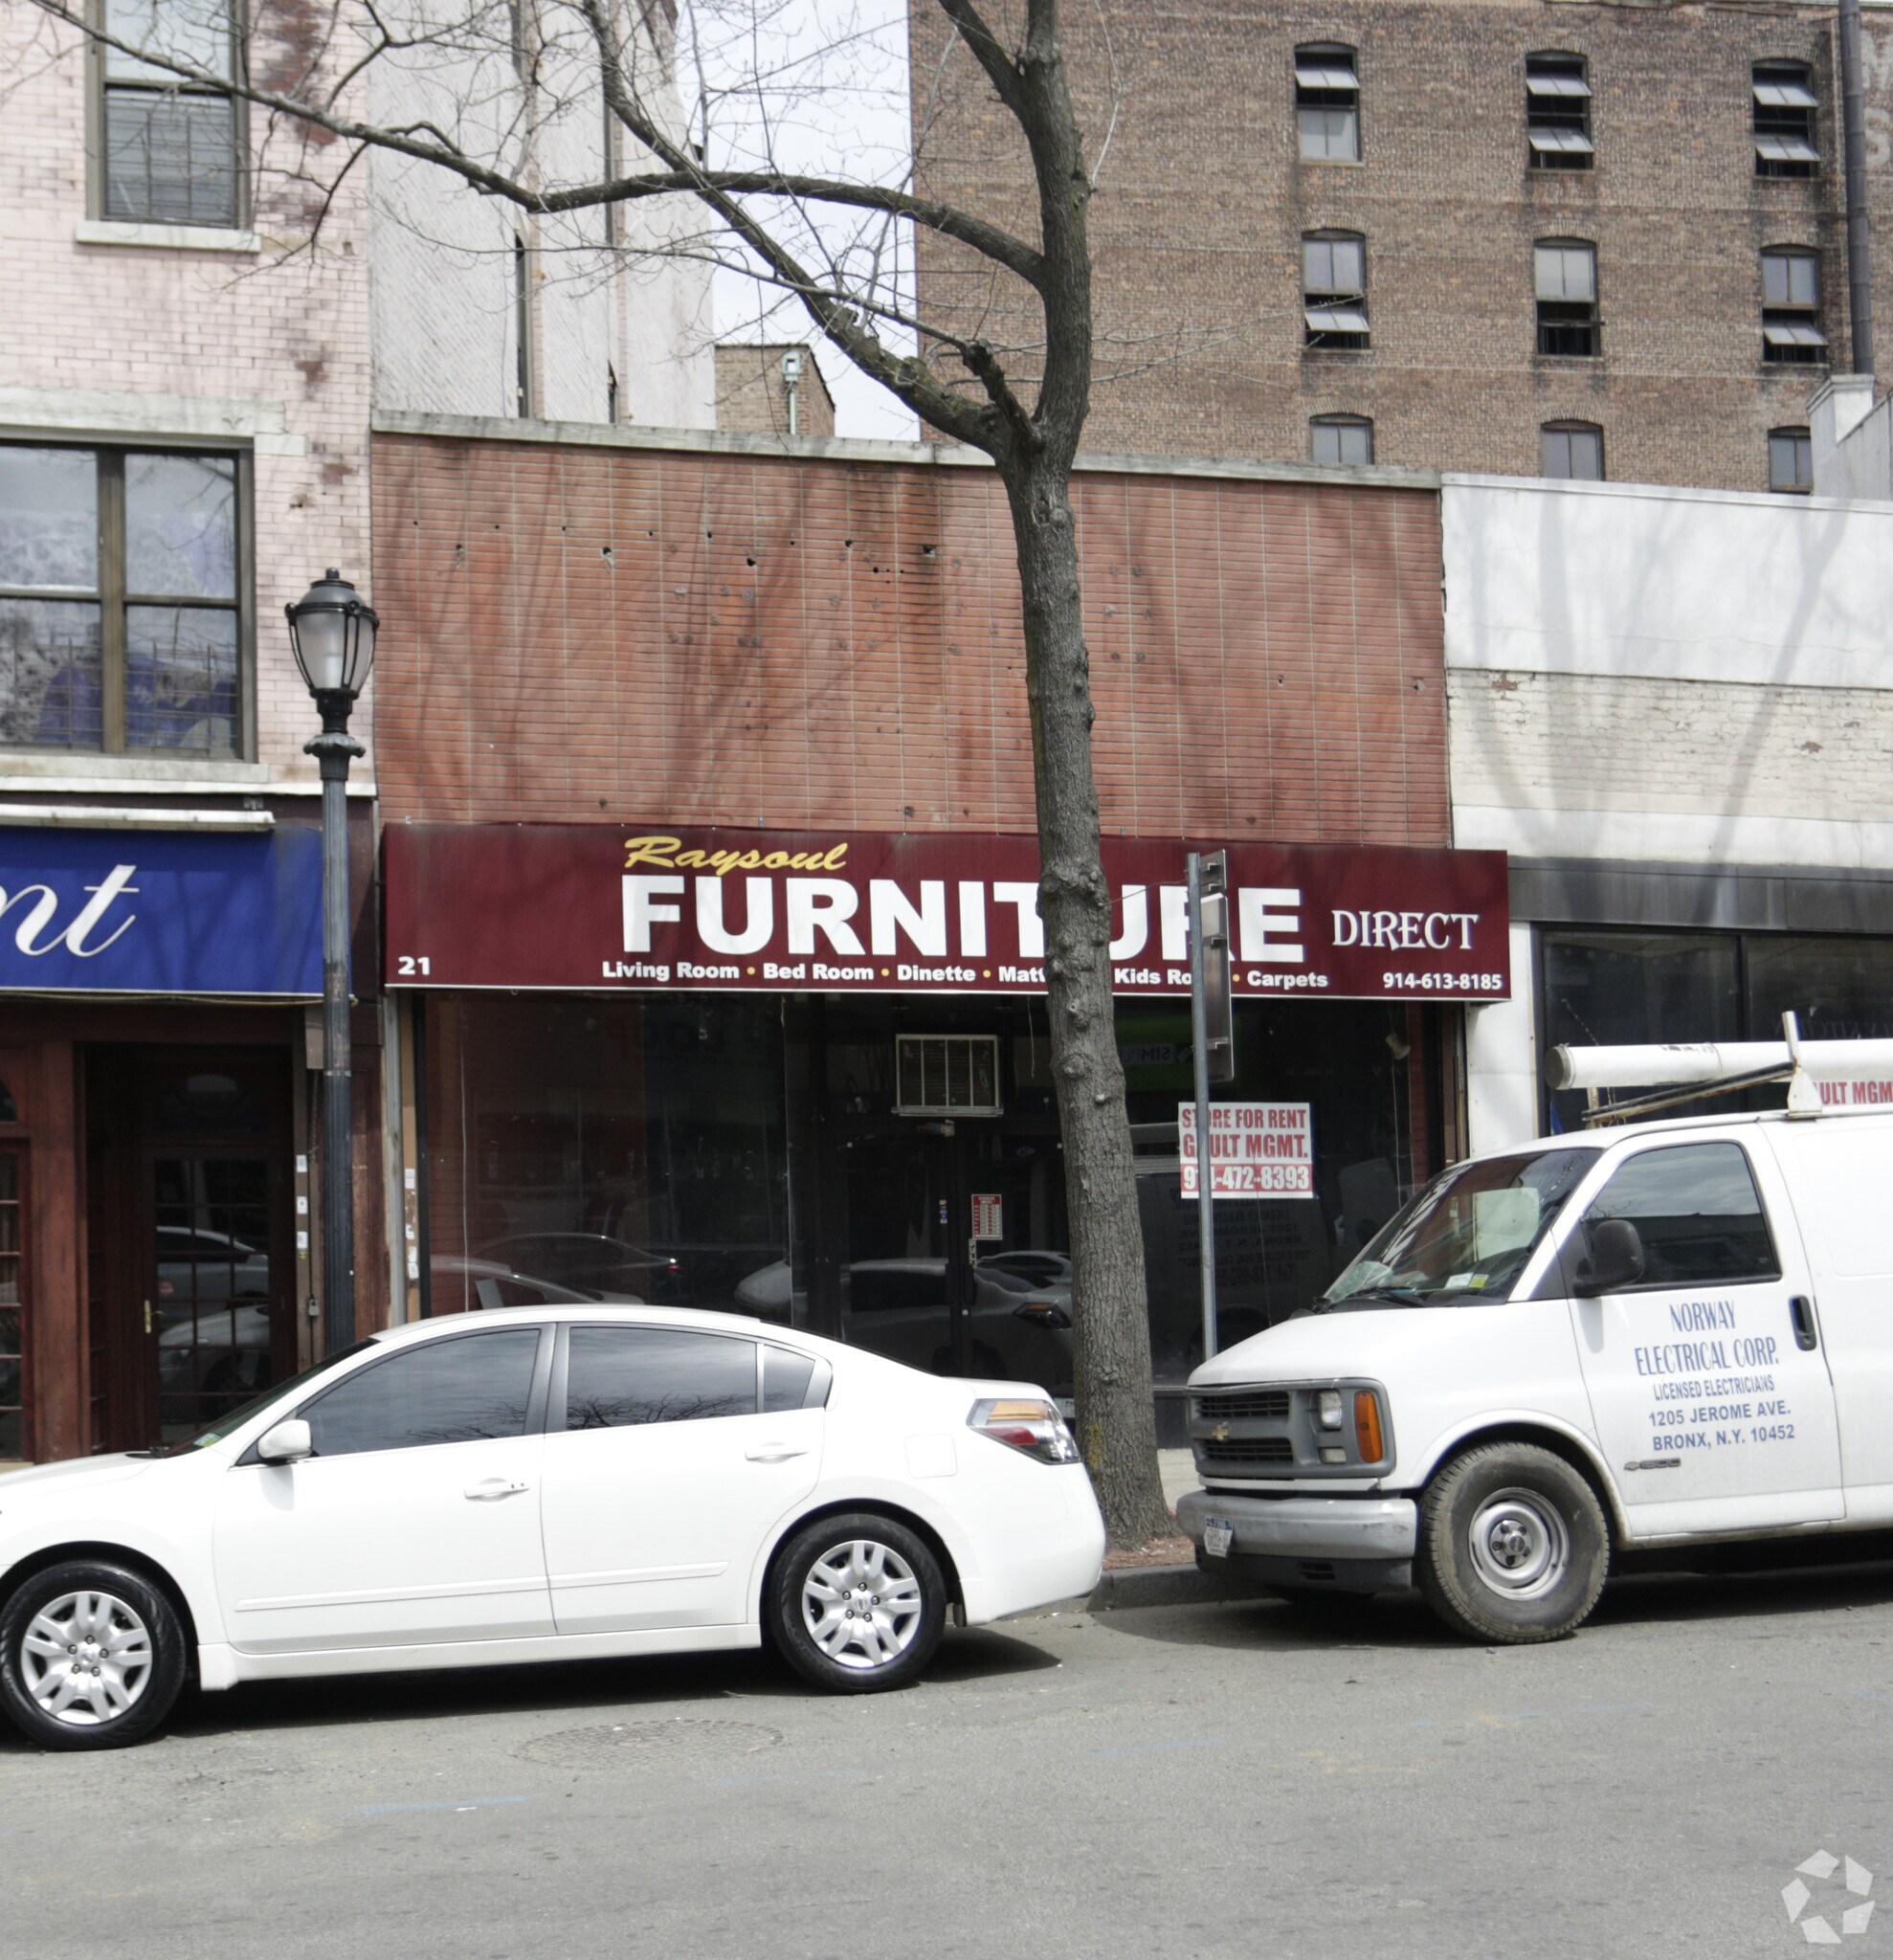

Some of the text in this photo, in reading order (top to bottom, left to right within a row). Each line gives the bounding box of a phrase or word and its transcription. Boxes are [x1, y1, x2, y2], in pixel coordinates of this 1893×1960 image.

[624, 835, 848, 876] Raysoul
[1331, 910, 1479, 951] DIRECT
[398, 956, 430, 976] 21
[602, 961, 670, 982] Living
[678, 962, 740, 979] Room
[764, 963, 806, 980] Bed
[813, 964, 874, 981] Room
[898, 965, 976, 982] Dinette
[1114, 968, 1161, 985] Kids
[1167, 969, 1193, 985] Ro
[1247, 970, 1328, 990] Carpets
[1383, 972, 1503, 991] 914-613-8185
[1815, 1081, 1847, 1104] ULT
[1182, 1108, 1306, 1128] SRE FOR RENT
[1183, 1133, 1308, 1158] GULT MGMT.
[1184, 1166, 1309, 1190] 9-472-8393
[1669, 1300, 1736, 1332] NORWAY
[1635, 1336, 1779, 1376] ELECTRICAL CORP.
[1653, 1374, 1775, 1401] LICENSED ELECTRICIANS
[1649, 1400, 1791, 1427] 1205 JEROME AVE.
[1653, 1424, 1795, 1451] BRONX, N.Y. 10452
